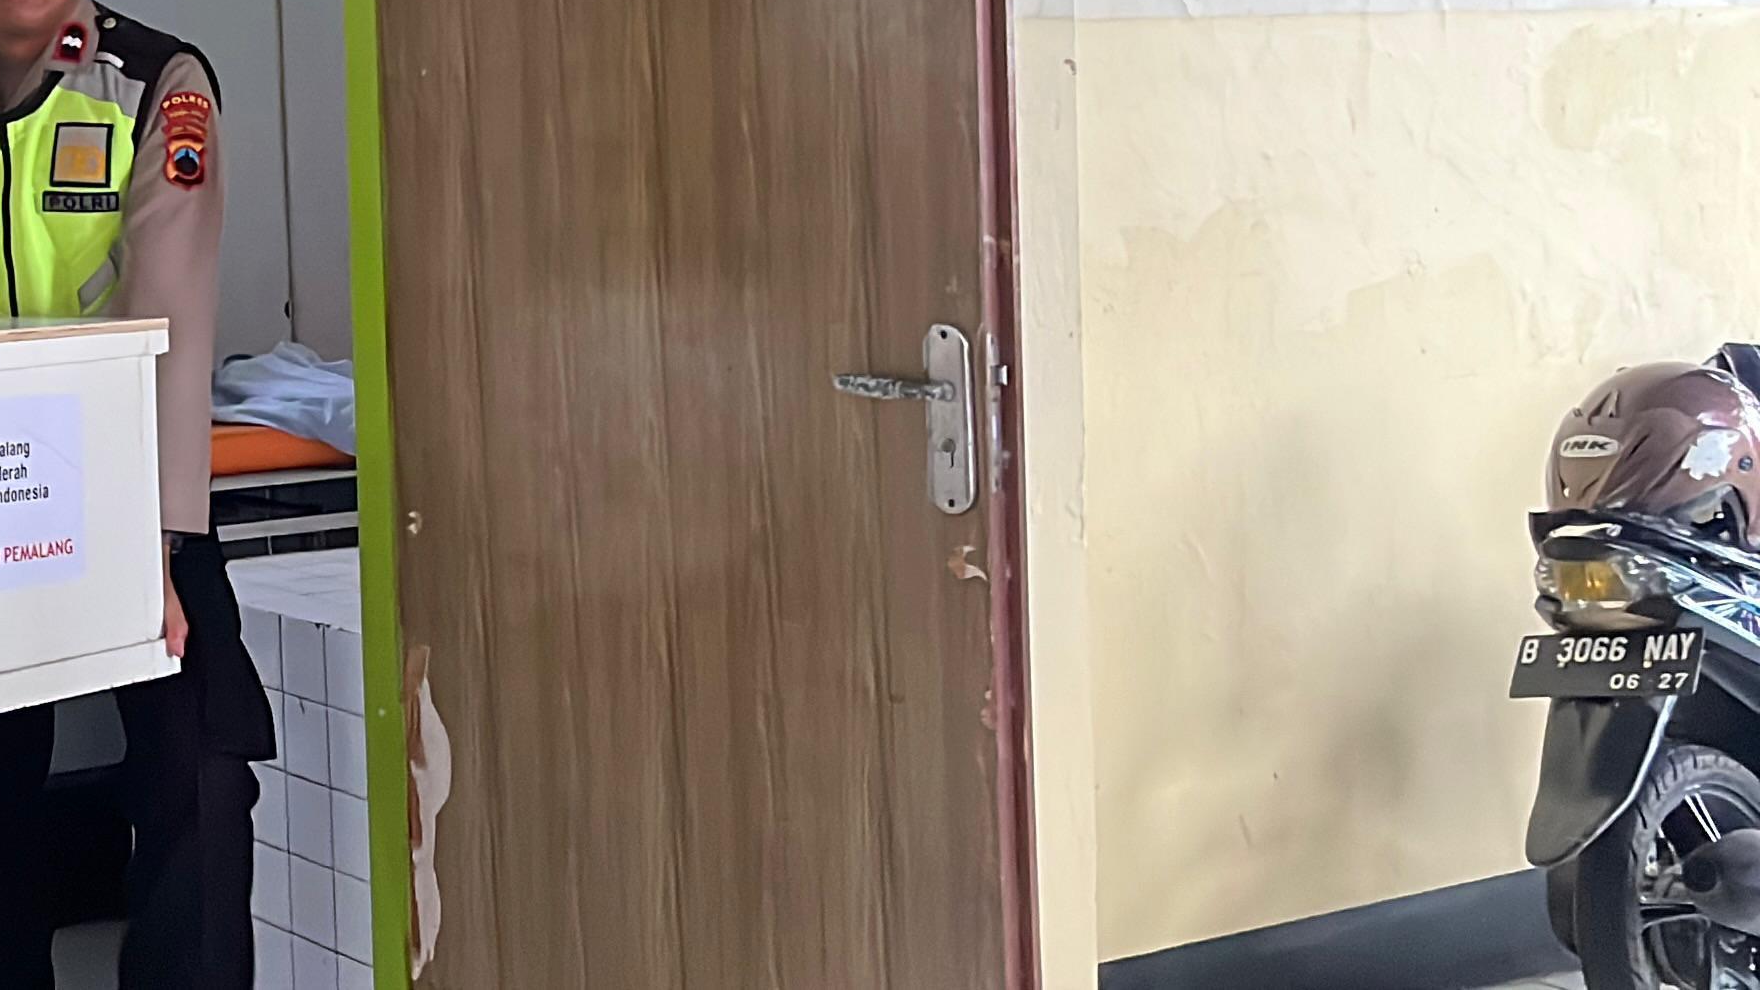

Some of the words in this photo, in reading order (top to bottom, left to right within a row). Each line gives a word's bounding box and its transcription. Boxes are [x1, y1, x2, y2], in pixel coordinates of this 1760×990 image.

[49, 194, 111, 211] POLRI
[4, 538, 74, 563] PEMALANG
[1521, 639, 1539, 664] B
[1556, 637, 1629, 664] 3066
[1643, 632, 1696, 663] NAY
[1609, 673, 1640, 690] 06
[1658, 672, 1689, 689] 27
